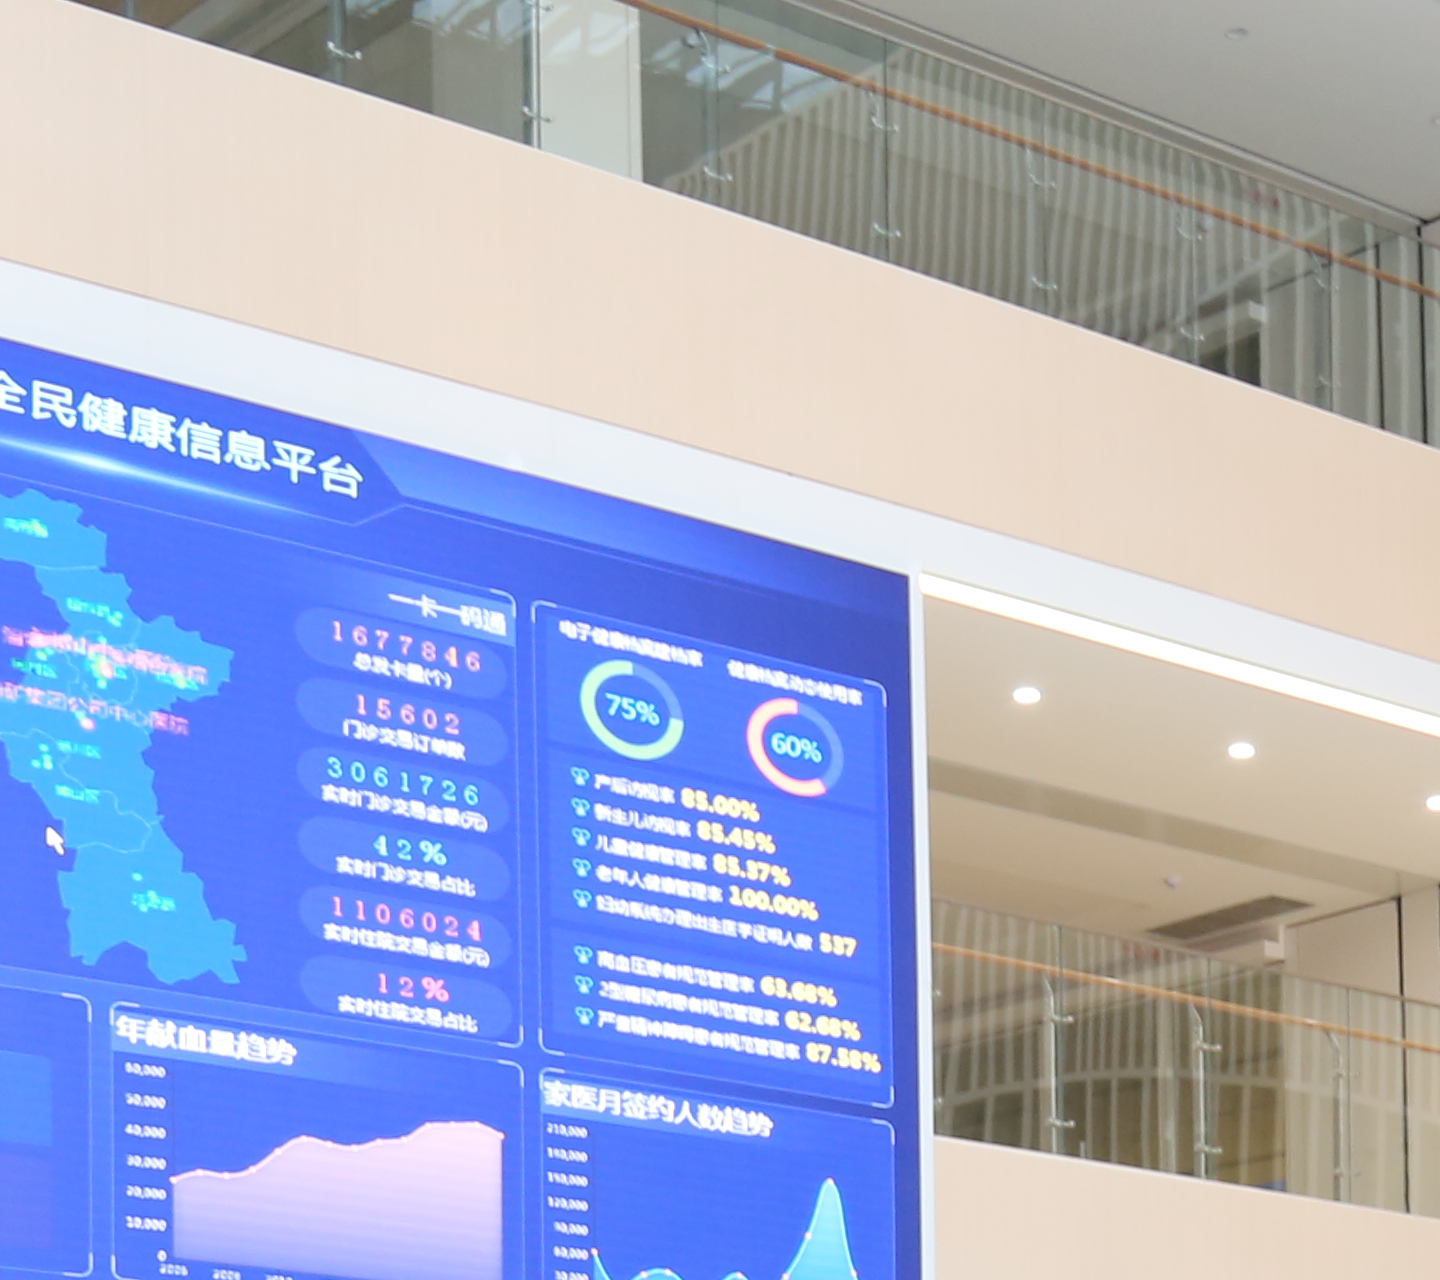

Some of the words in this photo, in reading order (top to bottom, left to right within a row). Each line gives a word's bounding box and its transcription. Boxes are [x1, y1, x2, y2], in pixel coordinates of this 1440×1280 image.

[605, 693, 660, 726] 75%
[771, 733, 822, 763] 60%
[374, 834, 448, 866] 42%
[378, 973, 450, 1002] 12%
[116, 1015, 297, 1066] 年献血量趋势
[544, 1081, 774, 1138] 家医月签约人数趋势
